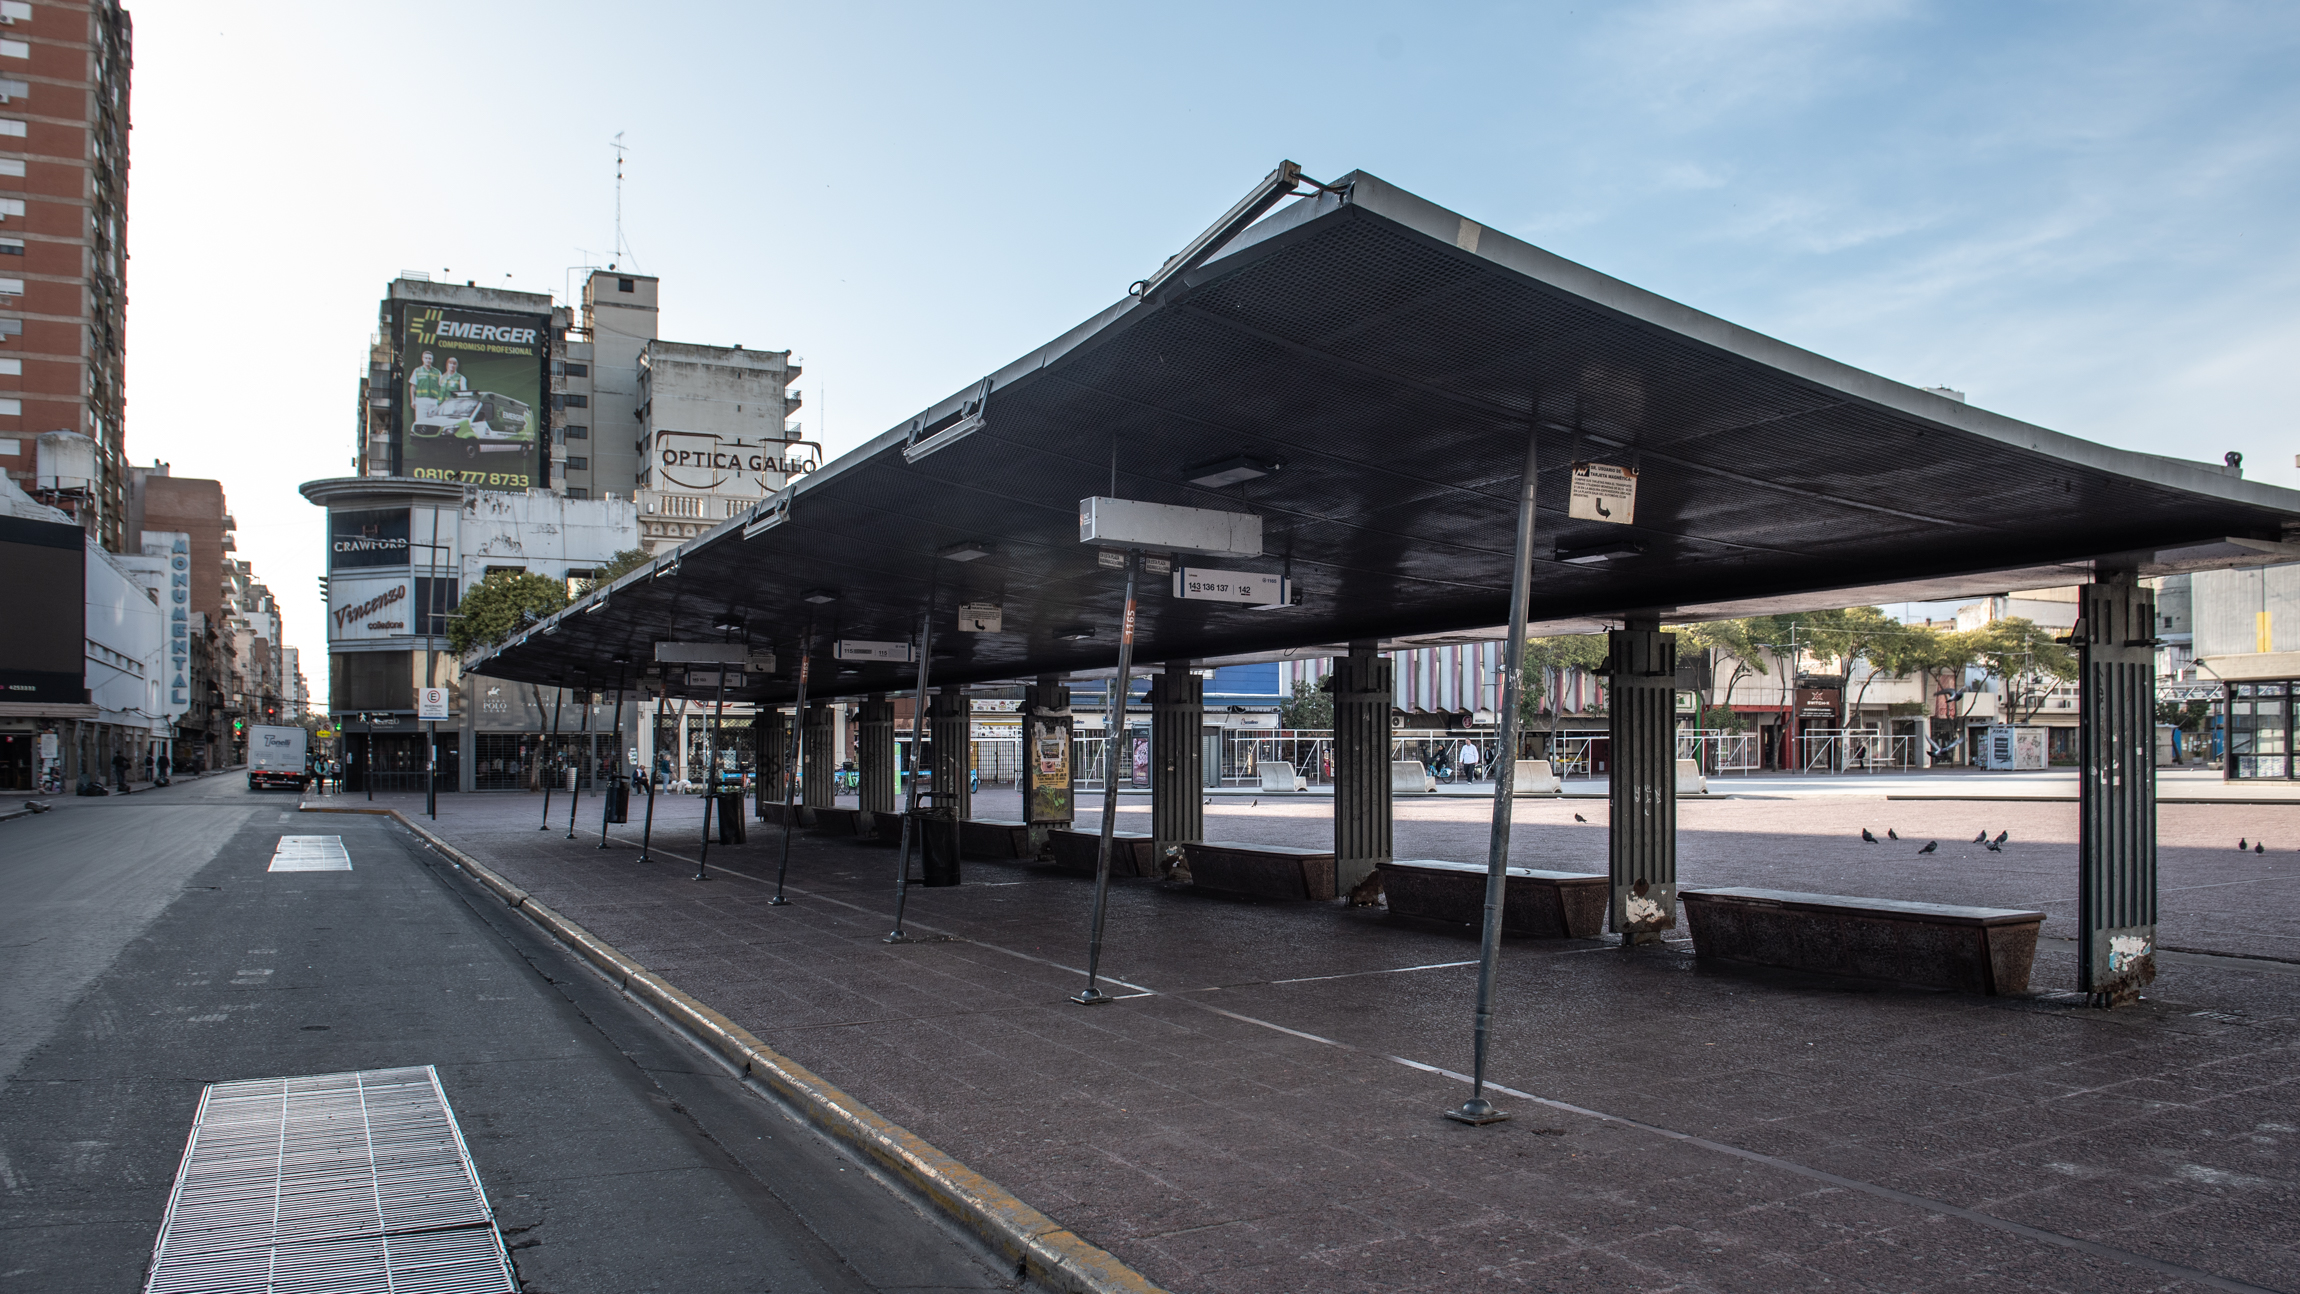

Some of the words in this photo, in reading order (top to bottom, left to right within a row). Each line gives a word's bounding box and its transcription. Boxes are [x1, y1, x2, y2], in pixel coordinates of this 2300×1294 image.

[436, 320, 536, 344] EMERGER
[438, 340, 486, 352] COMPROMISO
[486, 344, 533, 356] PROFESIONAL
[662, 449, 743, 470] OPTICA
[748, 455, 817, 474] GALLO
[460, 470, 486, 484] 777
[489, 473, 529, 487] 8733
[334, 538, 407, 552] CRAWFORD
[1189, 582, 1201, 590] 143
[1202, 583, 1215, 591] 136
[1216, 584, 1228, 592] 137
[1239, 586, 1251, 594] 142
[333, 585, 406, 629] Vincenzo
[171, 539, 188, 704] MONUMENTAL
[1125, 610, 1135, 636] 1165
[430, 693, 436, 701] E
[264, 735, 291, 747] Tonelli
